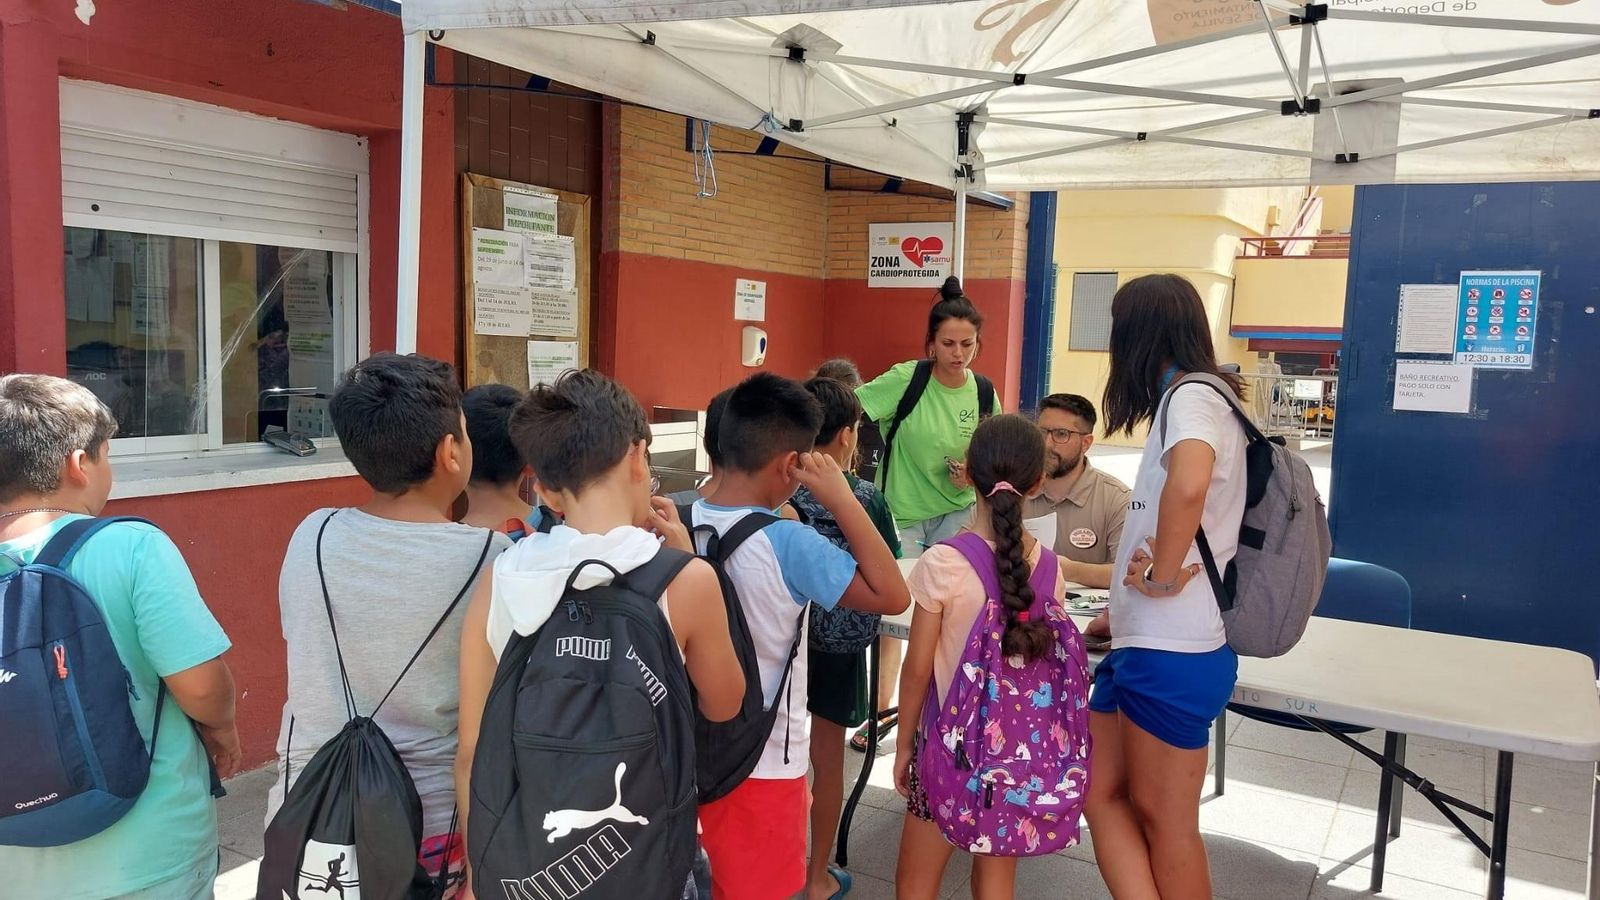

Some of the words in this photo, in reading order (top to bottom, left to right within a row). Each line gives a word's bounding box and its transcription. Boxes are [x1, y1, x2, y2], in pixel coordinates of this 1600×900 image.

[871, 256, 900, 268] ZONA
[870, 269, 940, 278] CARDIOPROTEGIDA
[1464, 354, 1488, 363] 12:30
[1500, 355, 1525, 364] 18:30
[85, 373, 107, 381] AOC
[1399, 373, 1418, 381] BAÑO
[1127, 500, 1146, 511] DS
[1285, 697, 1318, 713] SUR
[15, 792, 59, 810] Quechua
